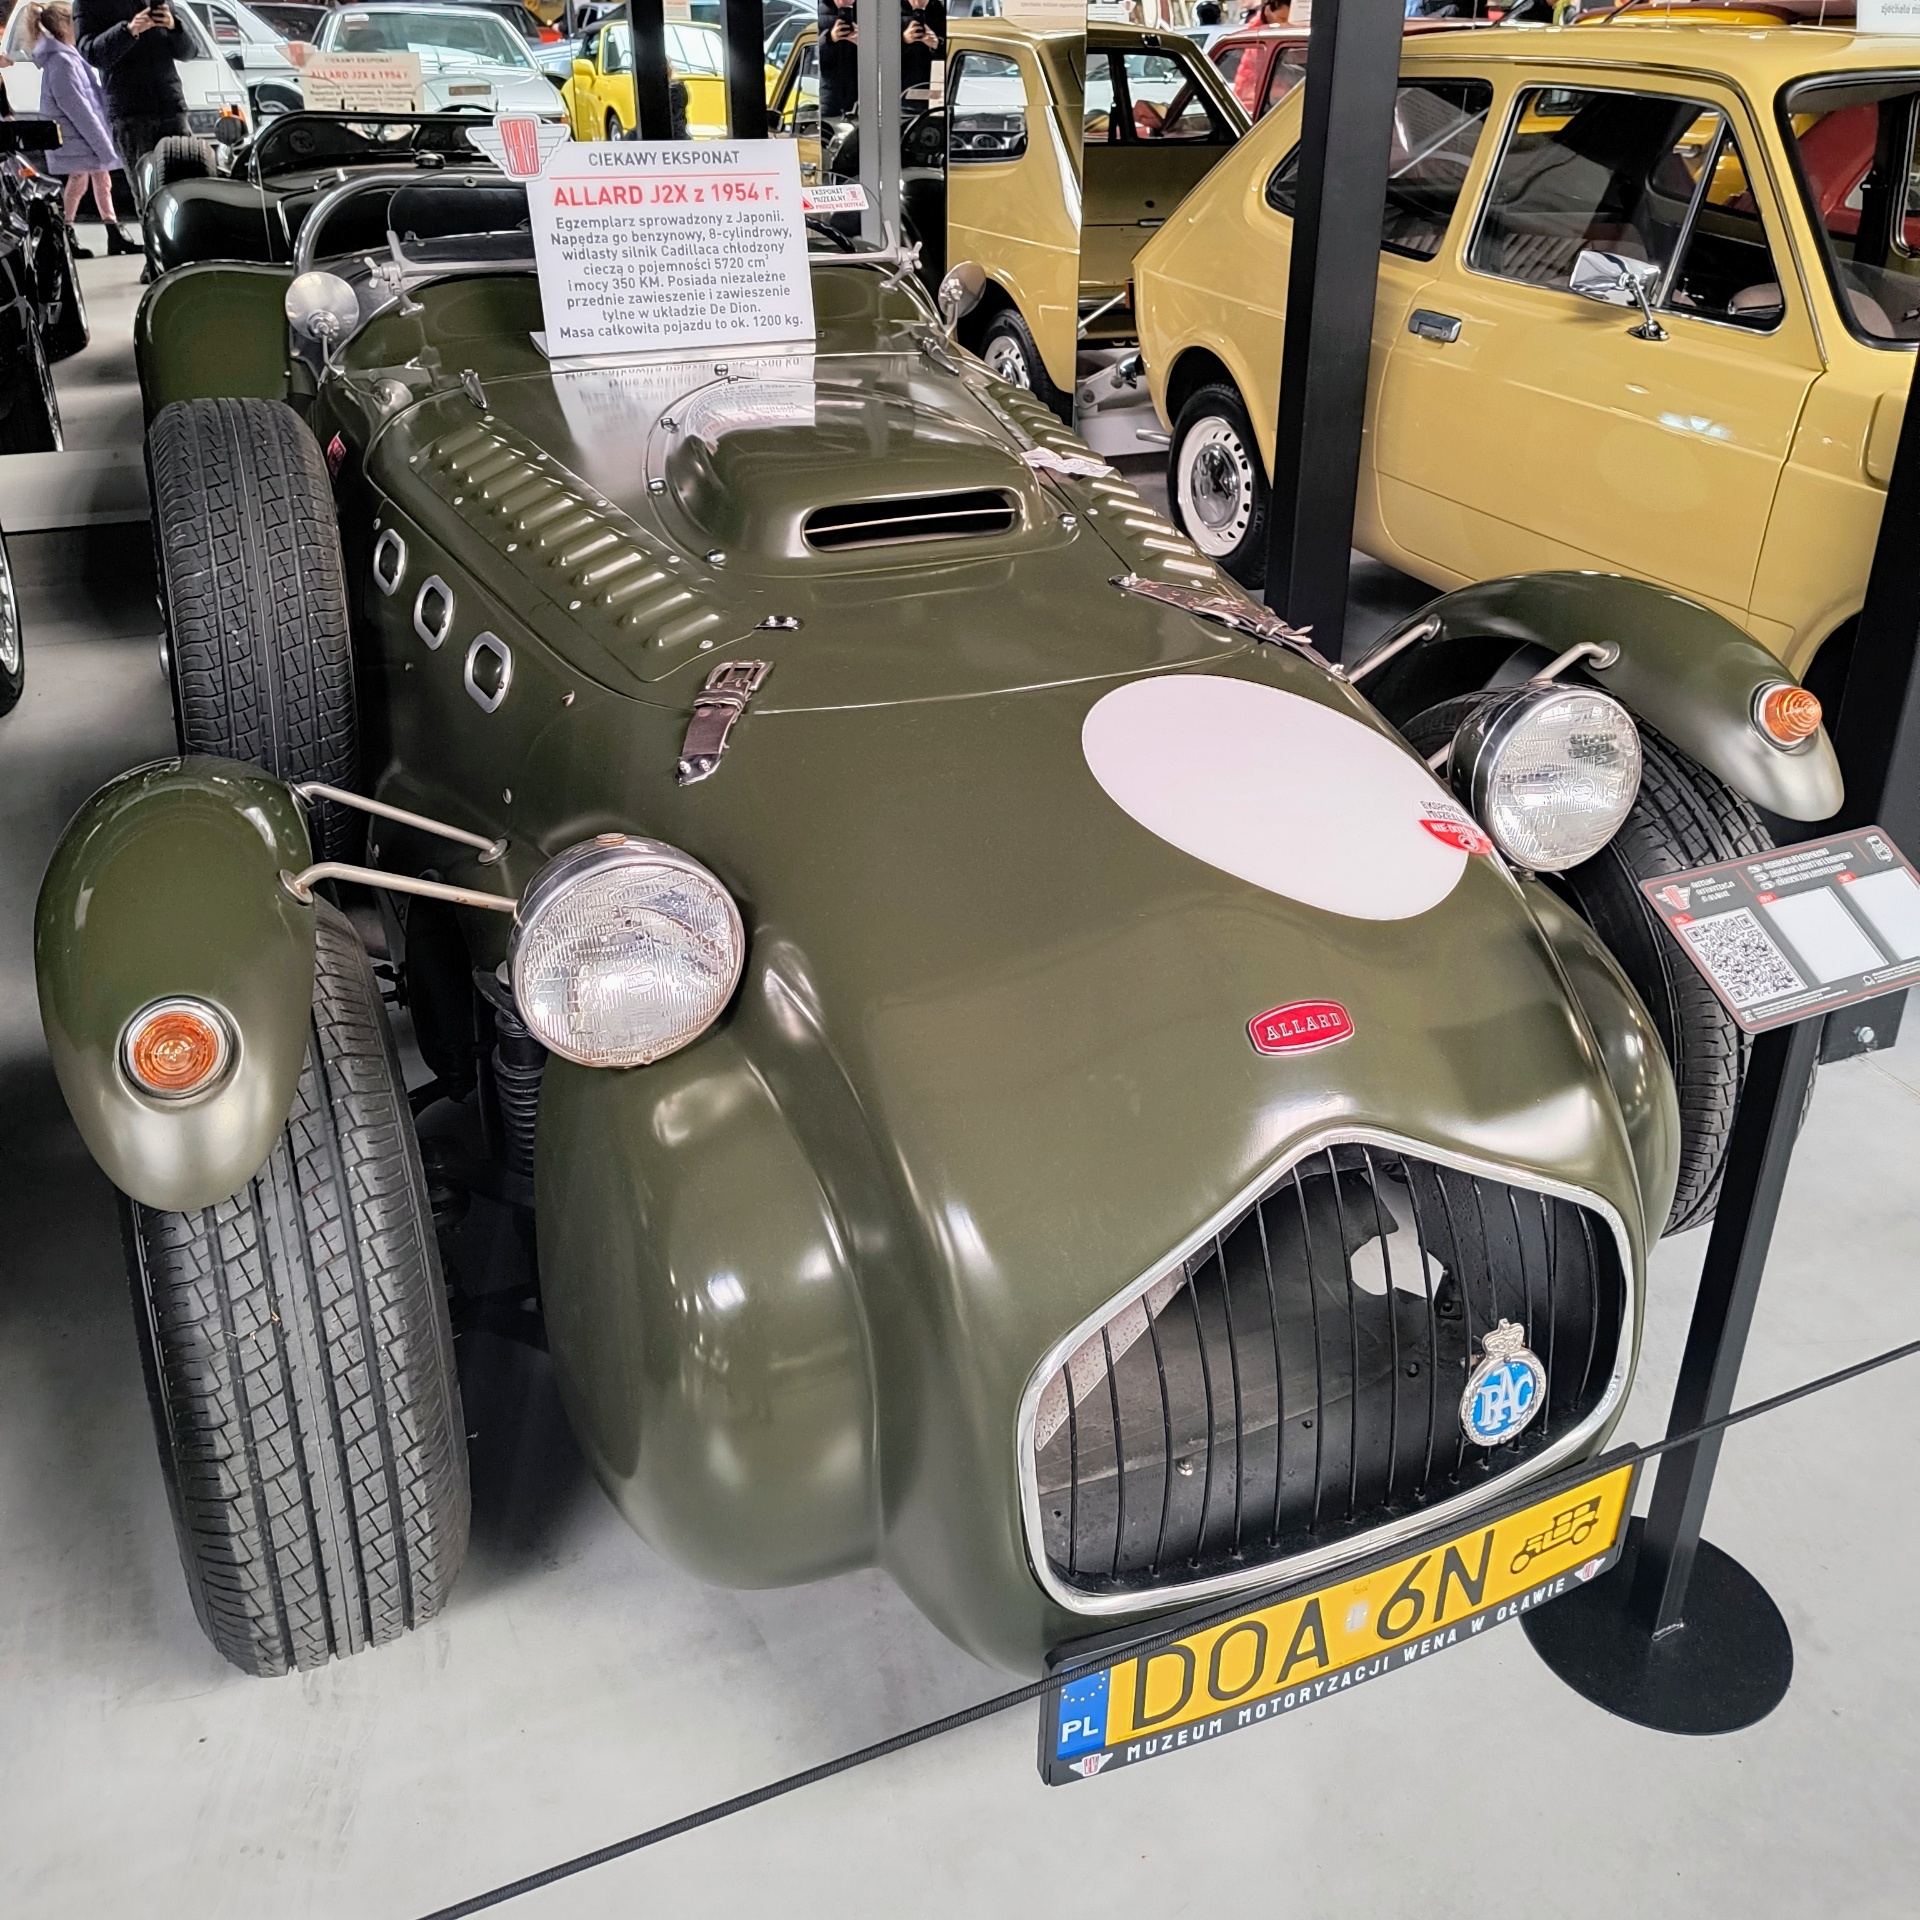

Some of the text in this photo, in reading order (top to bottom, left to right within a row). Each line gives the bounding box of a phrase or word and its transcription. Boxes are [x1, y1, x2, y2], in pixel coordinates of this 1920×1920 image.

[588, 150, 740, 167] CIEKAWY EKSPONAT
[554, 182, 779, 207] ALLARD J2X z 1954 r.
[811, 187, 843, 196] EKSPONAT
[813, 195, 846, 203] MUZEALNY
[556, 210, 784, 231] Egzemplarz sprowadzony z Japonii.
[551, 226, 792, 247] Napędza go benzynowy, 8-cylindrowy,
[562, 241, 785, 261] widlasty silnik Cadillaca chłodzony
[583, 263, 624, 277] cieczą
[627, 265, 635, 273] o
[639, 258, 711, 275] pojemności
[714, 257, 744, 269] 5720
[568, 271, 786, 292] i mocy 350 KM. Posiada niezależne
[567, 285, 791, 310] przednie zawieszenie i zawieszenie
[602, 302, 761, 323] tylne w układzie De Dion.
[560, 314, 803, 338] Masa całkowita pojazdu to ok. 1200 kg.
[1266, 1012, 1342, 1041] ALLARD
[1477, 1365, 1535, 1431] RAC
[1132, 1529, 1495, 1731] DOA 6N
[1126, 1577, 1566, 1763] MUZEUM MOTORYZACJI WENA W OŁAWIE
[1061, 1716, 1099, 1743] PL
